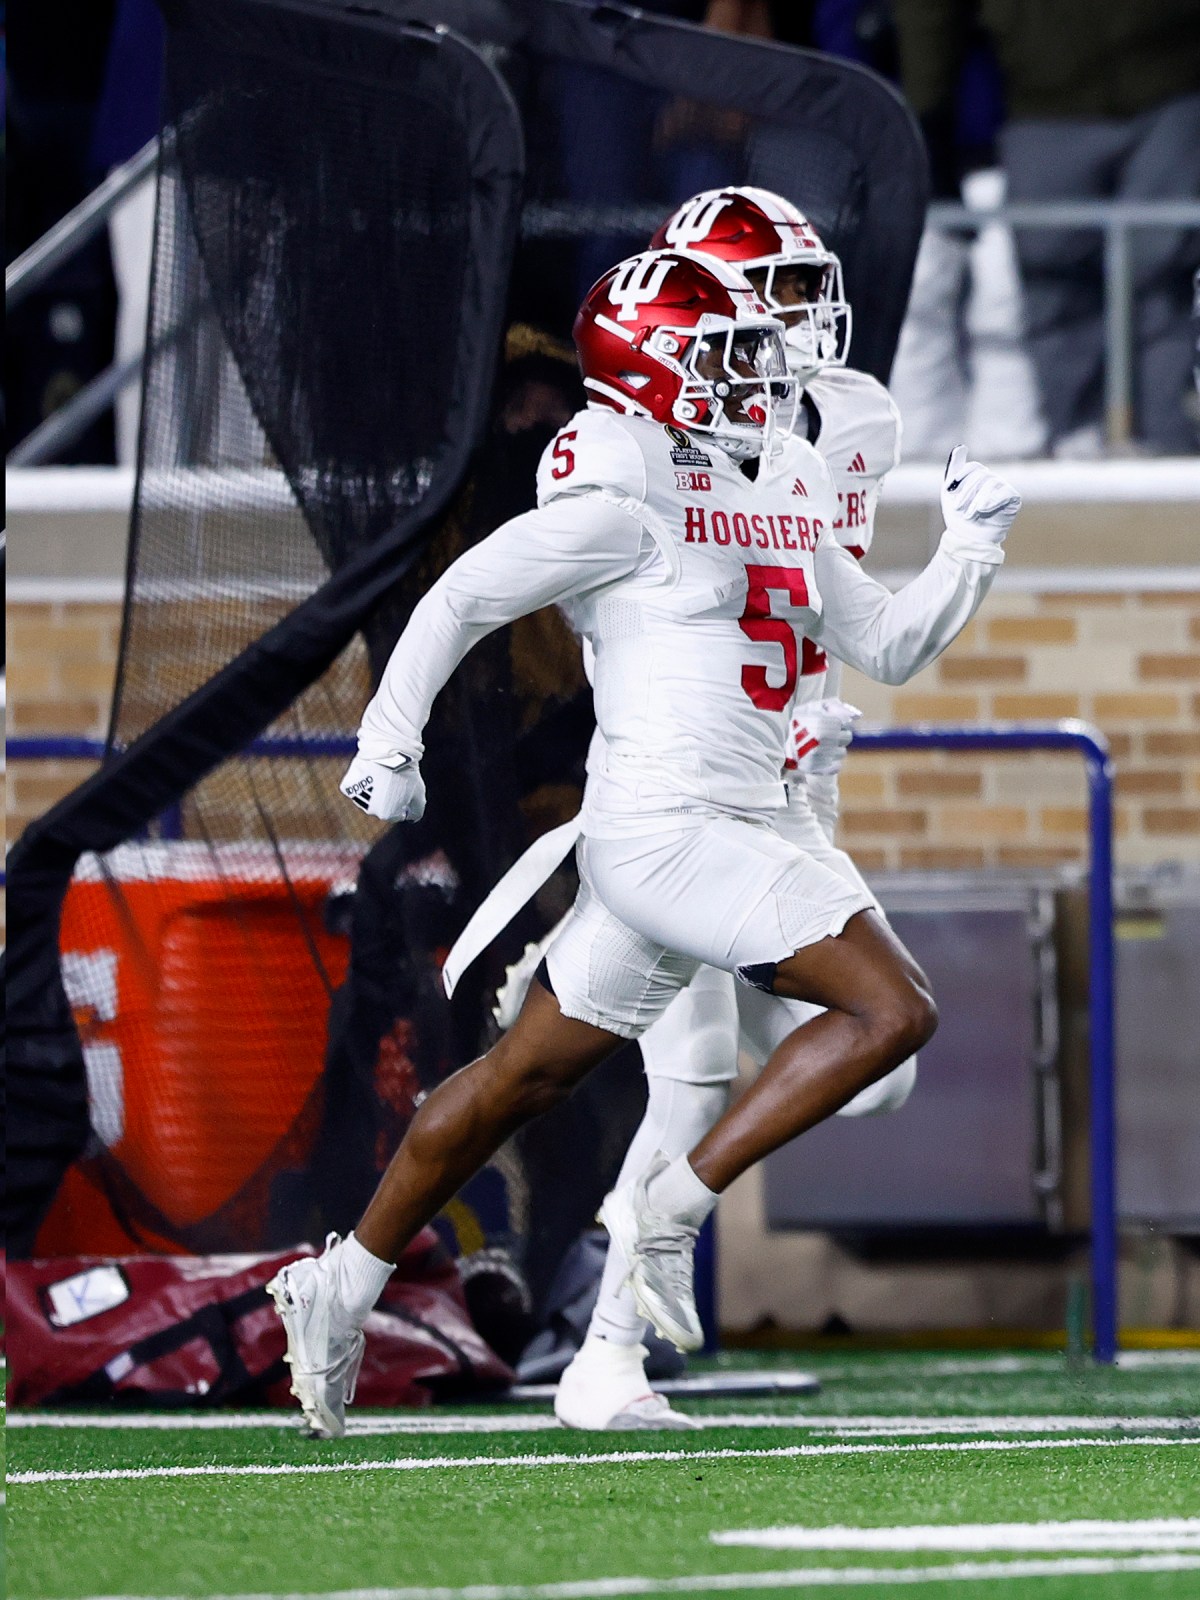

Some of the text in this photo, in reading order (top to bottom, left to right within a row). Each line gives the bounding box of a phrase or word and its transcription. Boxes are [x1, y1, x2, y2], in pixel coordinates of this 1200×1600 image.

[551, 430, 578, 480] 5
[684, 507, 824, 553] HOOSIERS
[738, 564, 810, 713] 5
